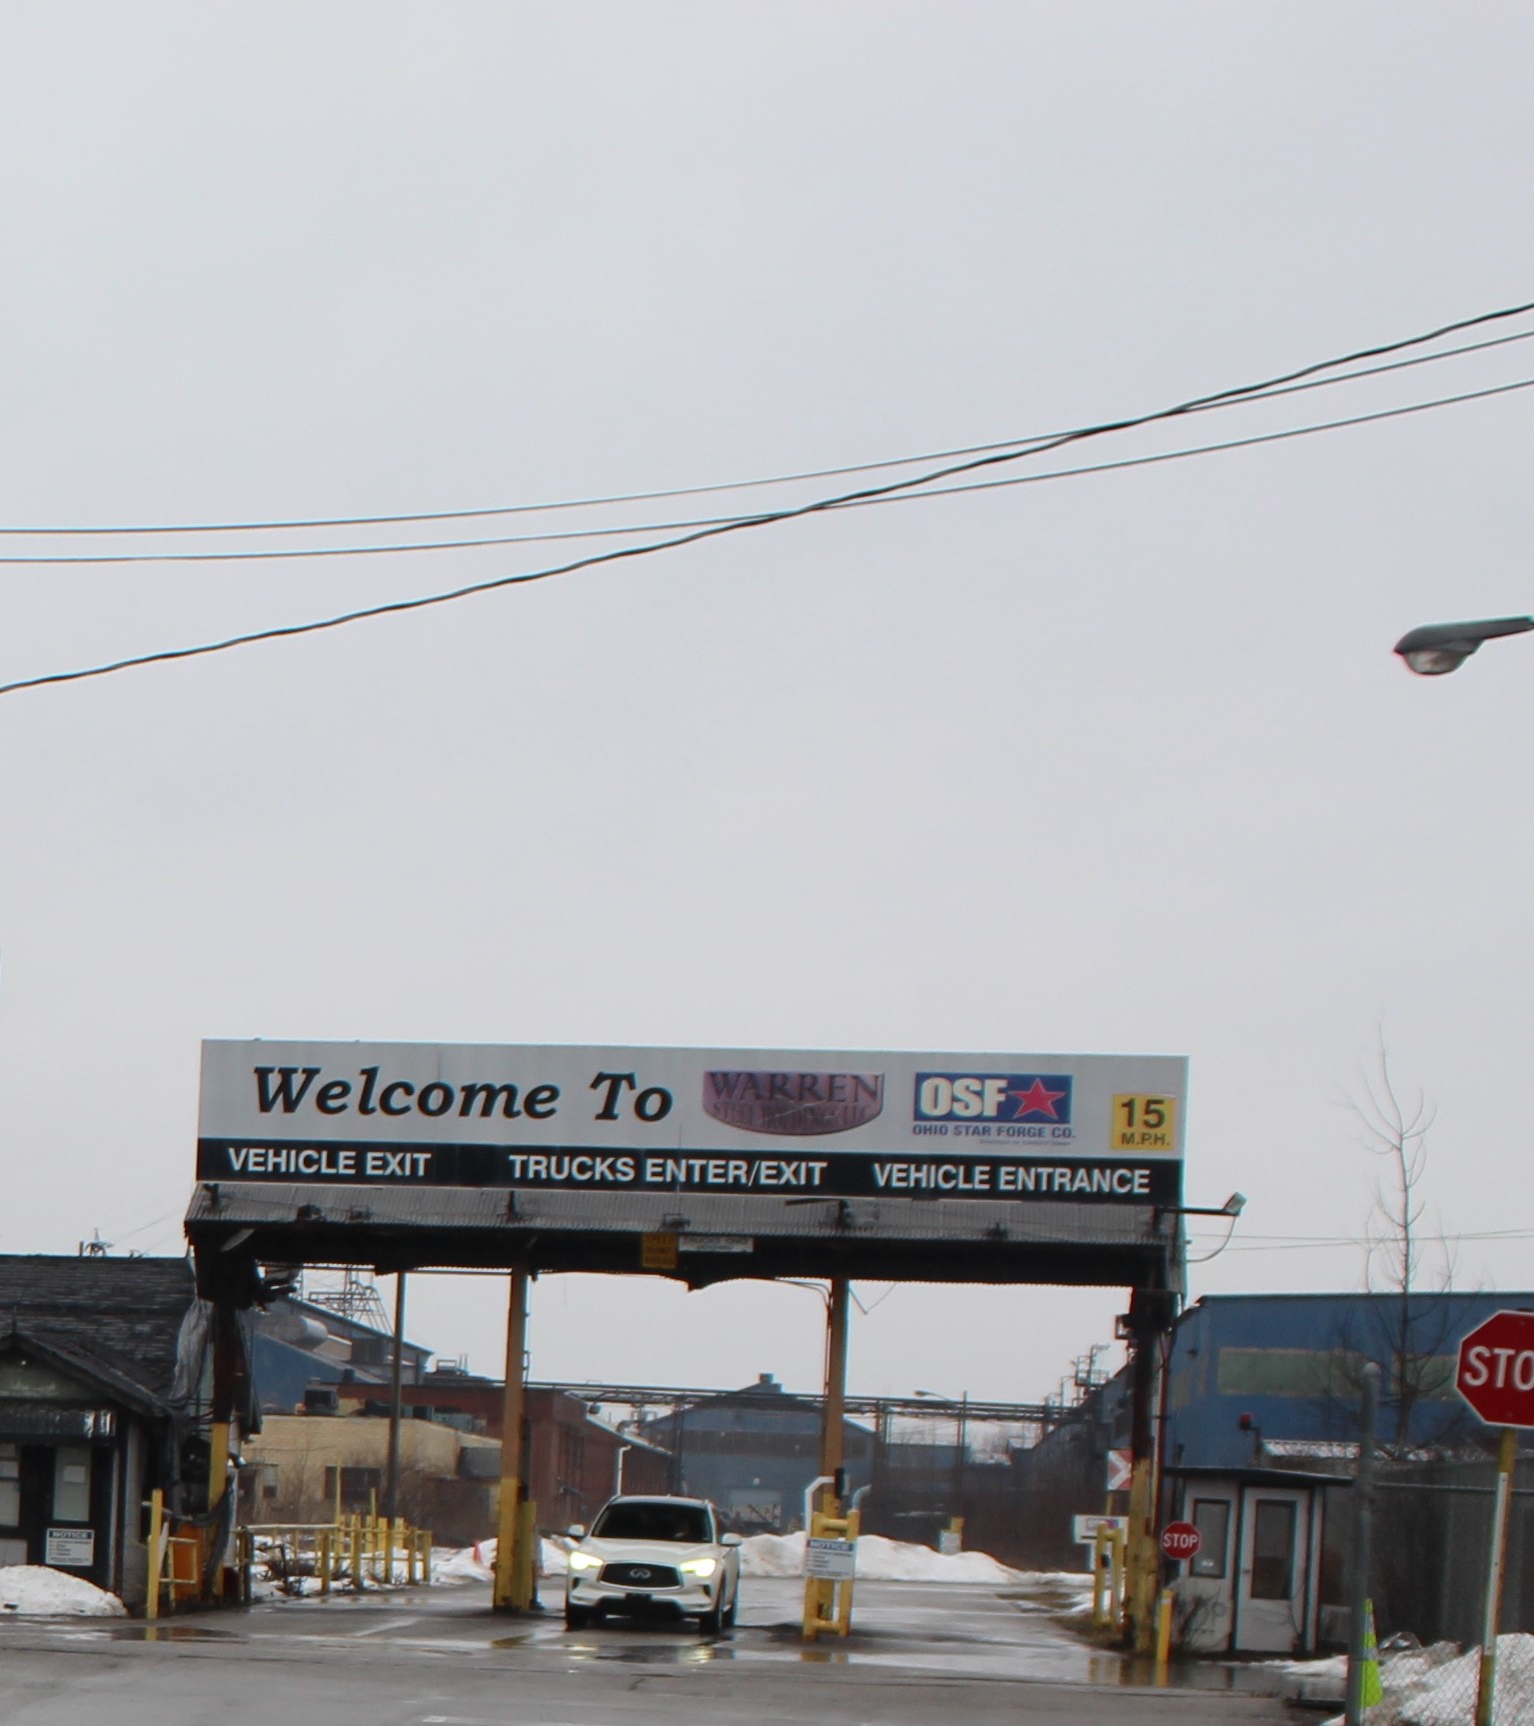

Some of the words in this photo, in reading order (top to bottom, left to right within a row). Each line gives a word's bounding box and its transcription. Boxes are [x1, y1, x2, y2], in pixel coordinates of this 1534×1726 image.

[253, 1065, 561, 1119] Welcome
[589, 1071, 673, 1122] To
[709, 1071, 885, 1103] WARREN
[919, 1076, 1010, 1118] OSF
[1120, 1097, 1166, 1130] 15
[912, 1124, 949, 1136] OHIO
[954, 1125, 992, 1137] STAR
[997, 1126, 1047, 1139] FORGE
[1052, 1127, 1076, 1139] CO.
[1120, 1132, 1171, 1146] M.P.H.
[228, 1147, 357, 1175] VEHICLE
[366, 1151, 432, 1177] EXIT
[508, 1154, 635, 1183] TRUCKS
[645, 1157, 828, 1187] ENTER/EXIT
[874, 1163, 991, 1189] VEHICLE
[998, 1165, 1151, 1194] ENTRANCE
[1463, 1345, 1534, 1391] STO
[1163, 1532, 1199, 1548] STOP
